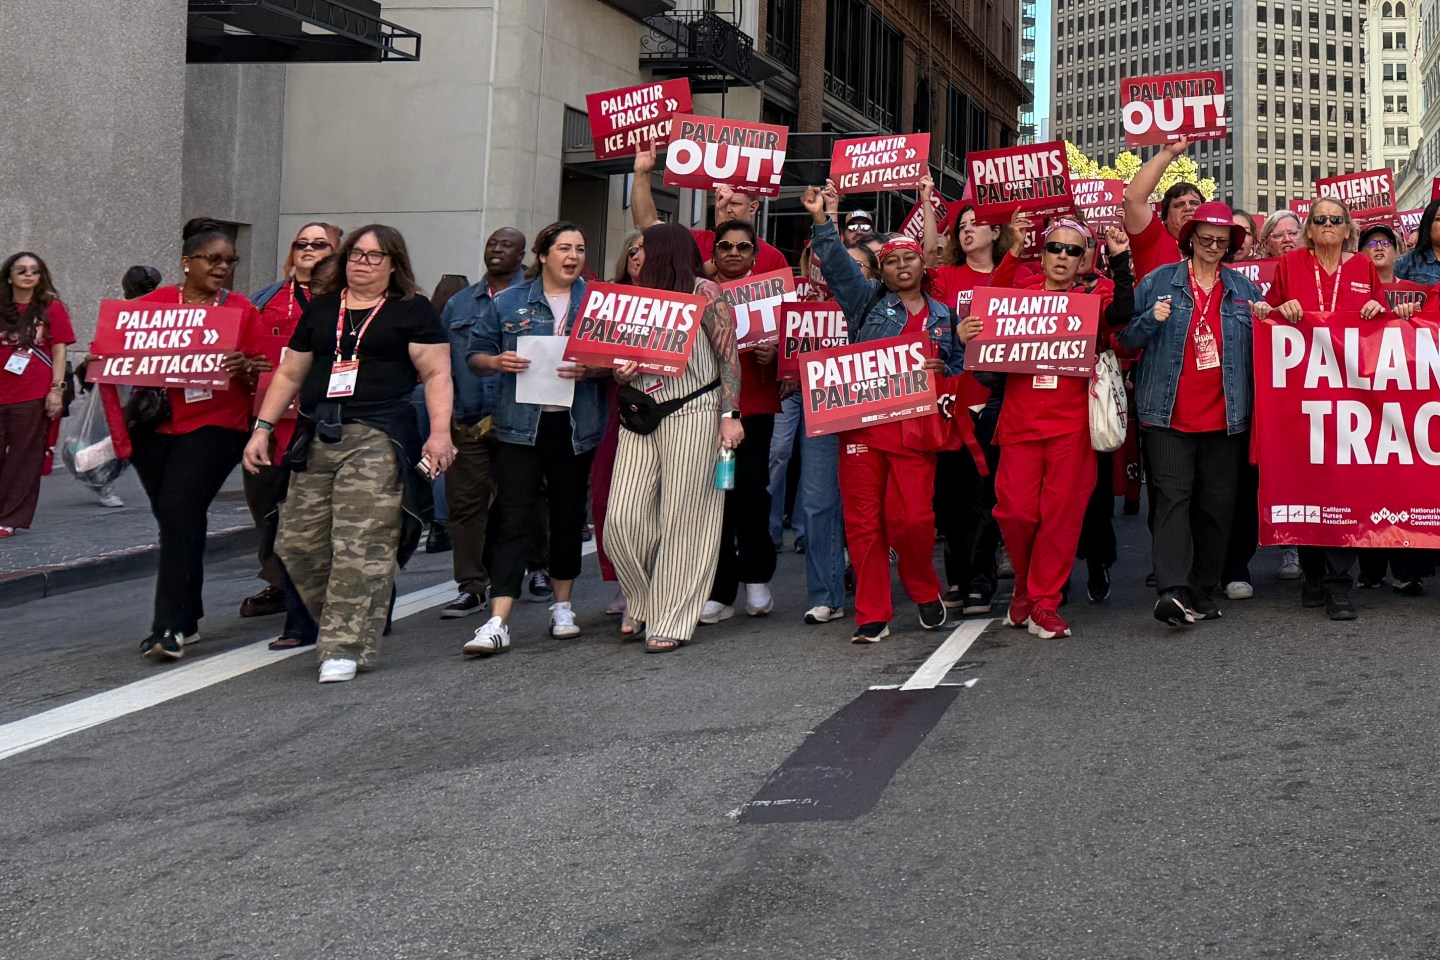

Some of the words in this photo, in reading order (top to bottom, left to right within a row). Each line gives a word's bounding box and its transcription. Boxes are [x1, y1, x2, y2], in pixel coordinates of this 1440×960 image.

[601, 85, 663, 116] PALANTIR
[1129, 79, 1217, 102] PALANTIR
[610, 103, 658, 130] TRACKS
[1122, 94, 1226, 135] OUT!
[604, 135, 624, 153] ICE
[627, 118, 673, 145] ATTACK
[680, 121, 780, 150] PALANTIR
[845, 137, 907, 157] PALANTIR
[665, 138, 787, 184] OUT!
[851, 149, 898, 169] TRACKS
[972, 149, 1064, 185] PATIENTS
[840, 170, 859, 189] ICE
[861, 163, 920, 186] ATTACKS!
[1005, 179, 1032, 191] OVER
[1072, 181, 1104, 194] LANTIR
[1320, 174, 1390, 198] PATIENTS
[976, 175, 1066, 206] PALANTIR
[1345, 196, 1366, 205] OVER
[1083, 206, 1117, 219] TACKS!
[583, 290, 697, 331] PATIENTS
[988, 296, 1068, 316] PALANTIR
[116, 309, 207, 330] PALANTIR
[616, 323, 650, 336] OVER
[996, 316, 1057, 337] TRACKS
[124, 329, 192, 350] TRACKS
[576, 317, 689, 354] PALANTIR
[978, 343, 1005, 363] ICE
[1007, 340, 1087, 362] ATTACKS!
[103, 357, 133, 377] ICE
[136, 353, 224, 376] ATTACKS!
[806, 341, 926, 390] PATIENTS
[810, 370, 930, 413] PALANTIR
[851, 378, 887, 393] OVER
